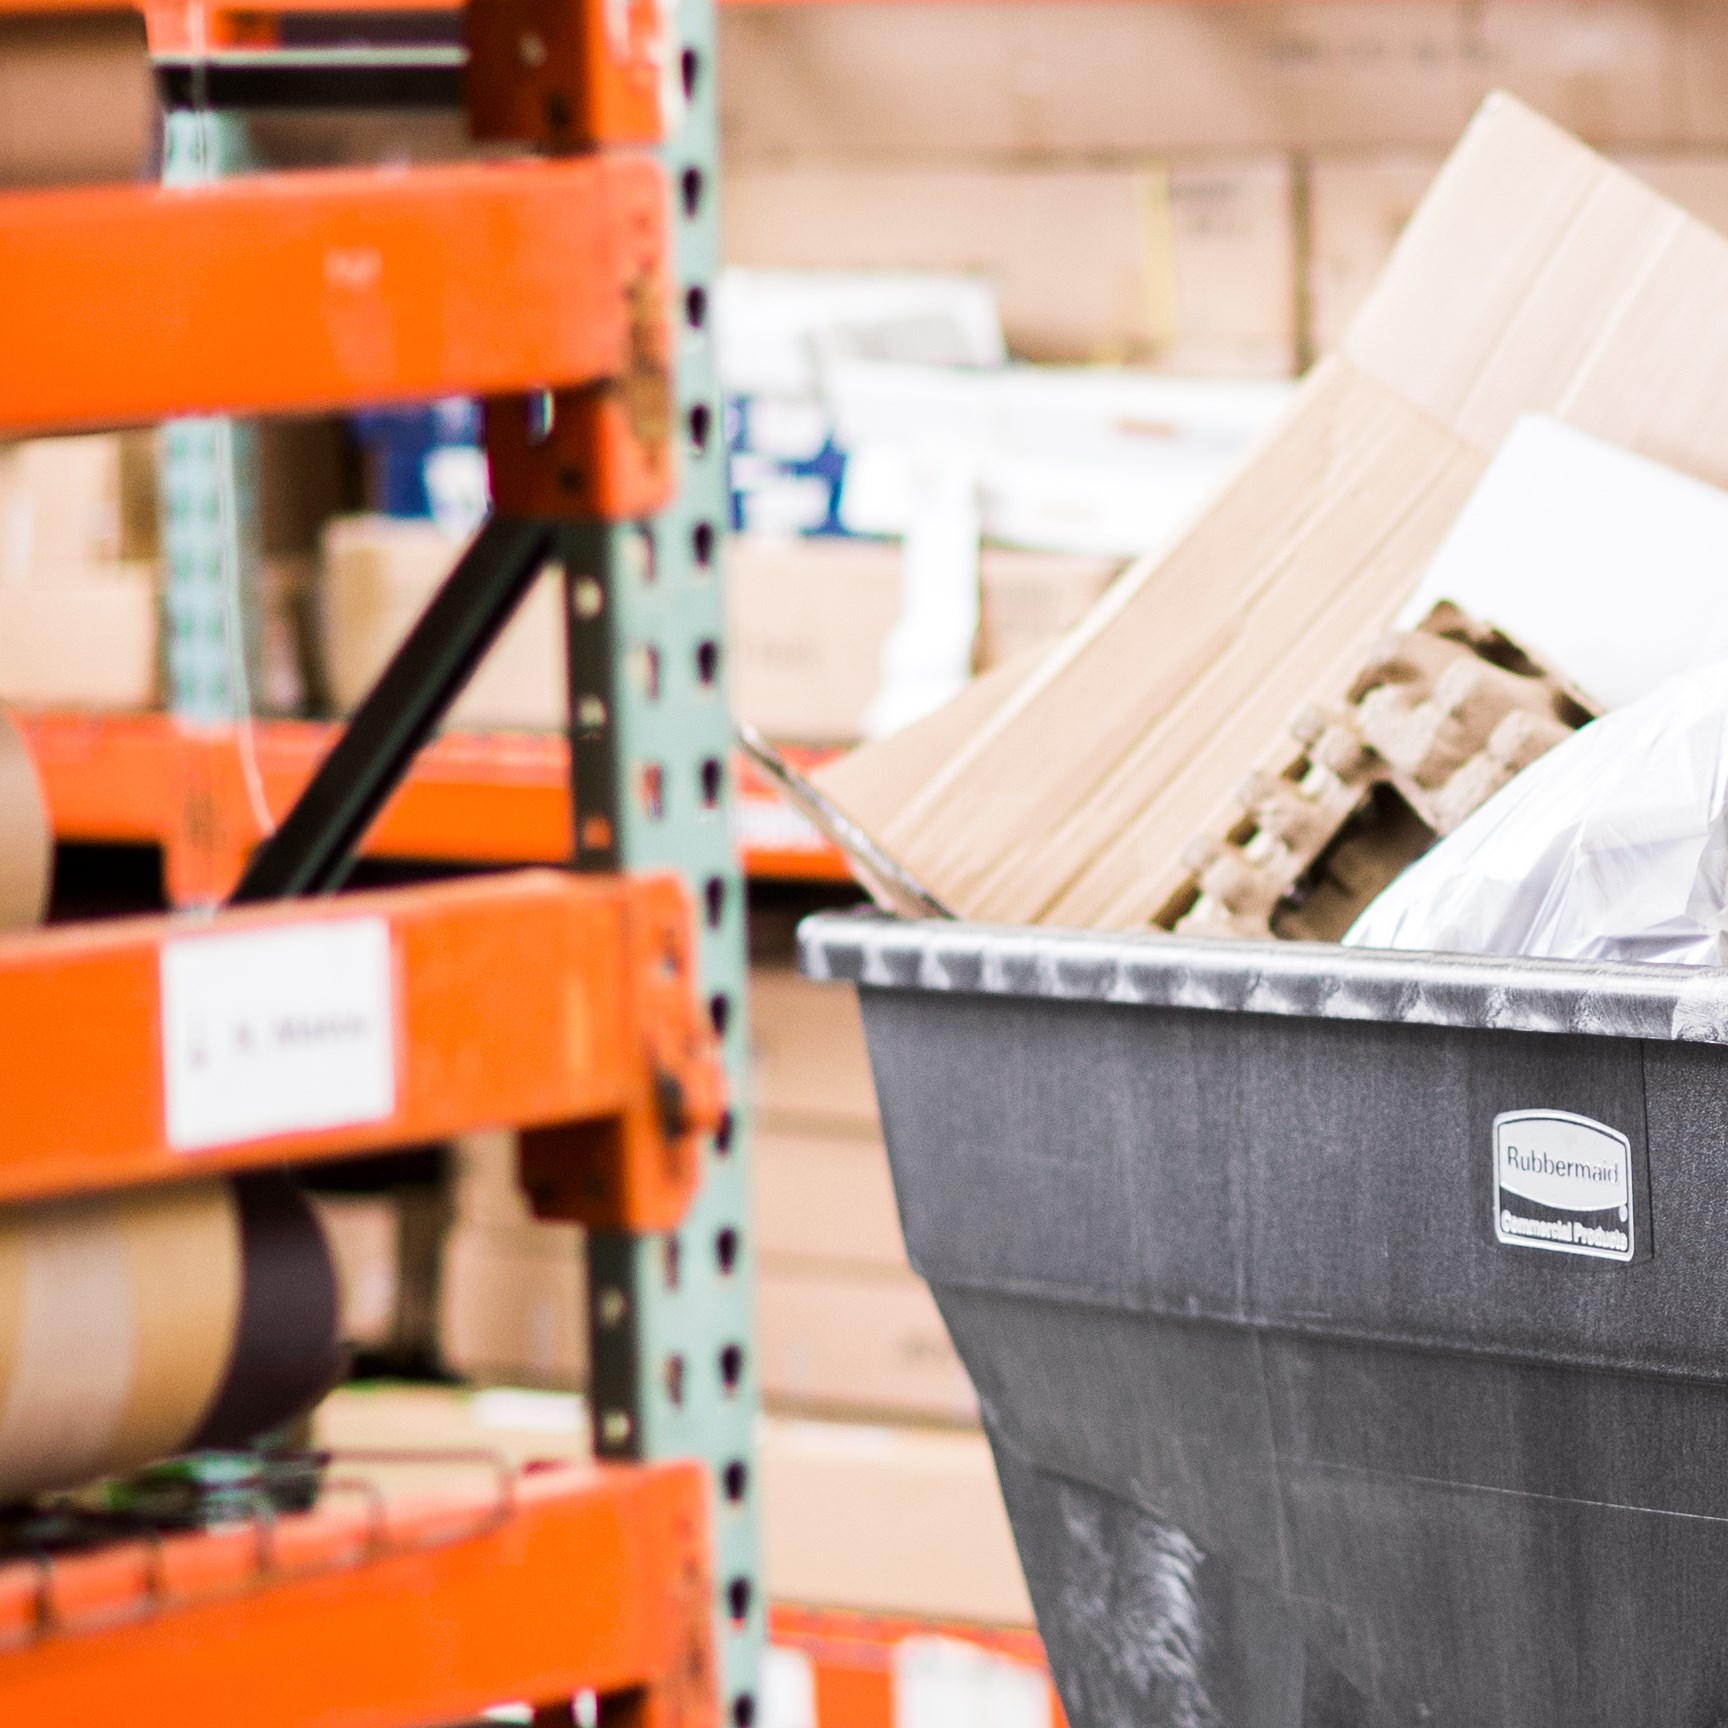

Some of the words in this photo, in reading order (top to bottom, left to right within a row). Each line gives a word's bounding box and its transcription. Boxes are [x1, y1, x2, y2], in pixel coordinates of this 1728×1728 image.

[1507, 1145, 1619, 1183] Rubbermaid
[1501, 1209, 1572, 1242] Commercial
[1573, 1222, 1628, 1251] Products
